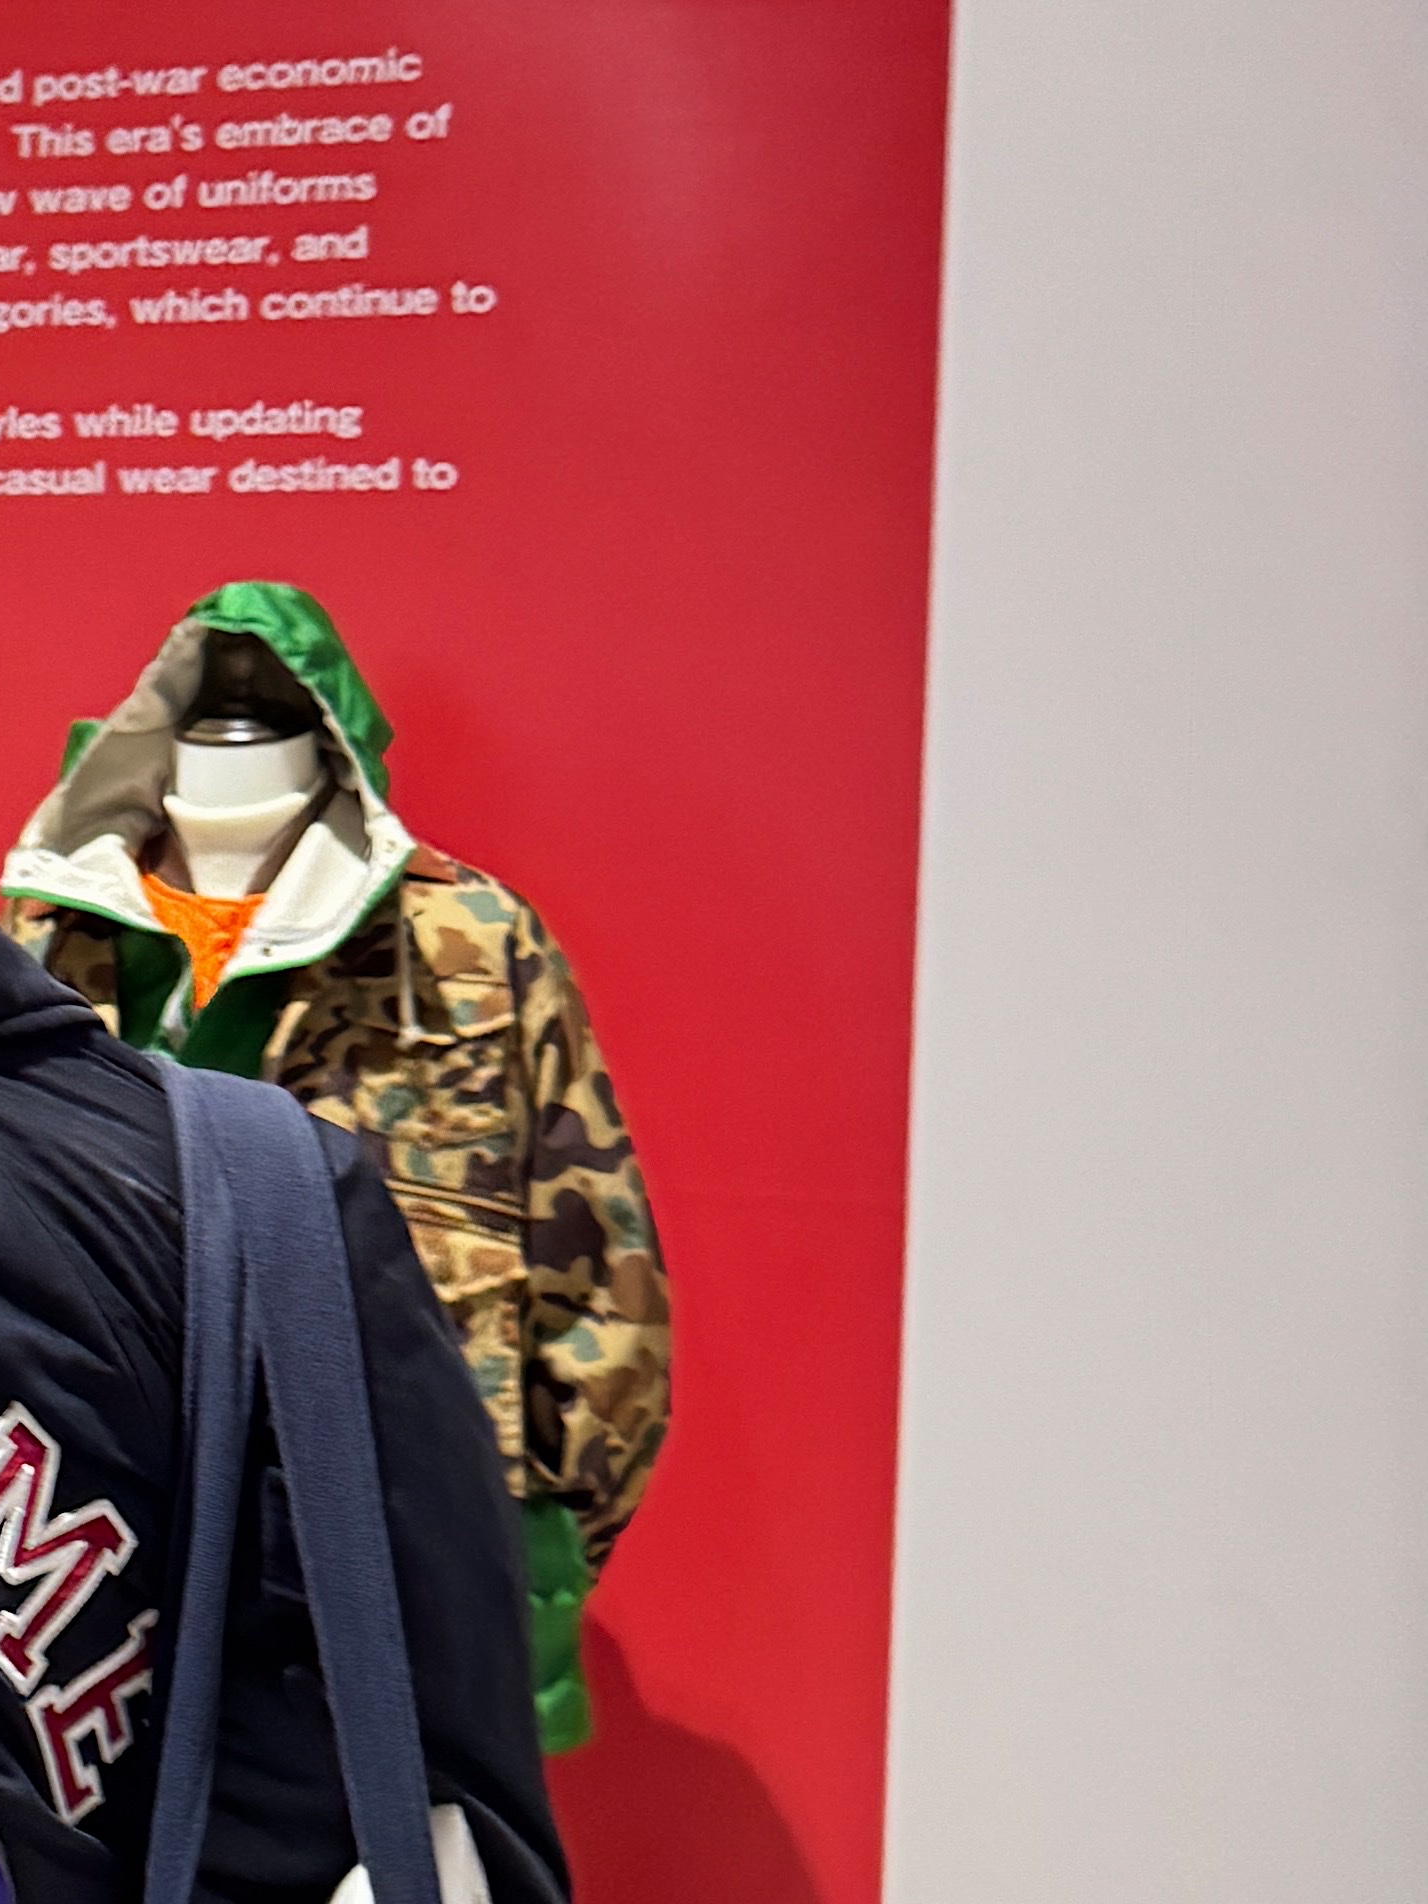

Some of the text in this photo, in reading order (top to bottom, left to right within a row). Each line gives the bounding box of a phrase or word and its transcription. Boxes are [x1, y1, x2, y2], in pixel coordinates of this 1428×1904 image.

[33, 66, 208, 106] post-war
[217, 49, 421, 91] economic
[11, 123, 95, 158] This
[106, 115, 204, 155] era's
[215, 114, 393, 149] embrace
[405, 103, 452, 140] of
[28, 185, 132, 214] wave
[143, 174, 187, 210] of
[198, 171, 377, 207] uniforms
[49, 236, 279, 274] sportswear,
[291, 224, 369, 261] and
[130, 288, 249, 323] which
[260, 283, 439, 320] continue
[451, 281, 497, 314] to
[74, 403, 179, 438] while
[190, 400, 363, 440] updating
[117, 466, 218, 494] wear
[228, 457, 401, 492] destined
[412, 458, 458, 489] to
